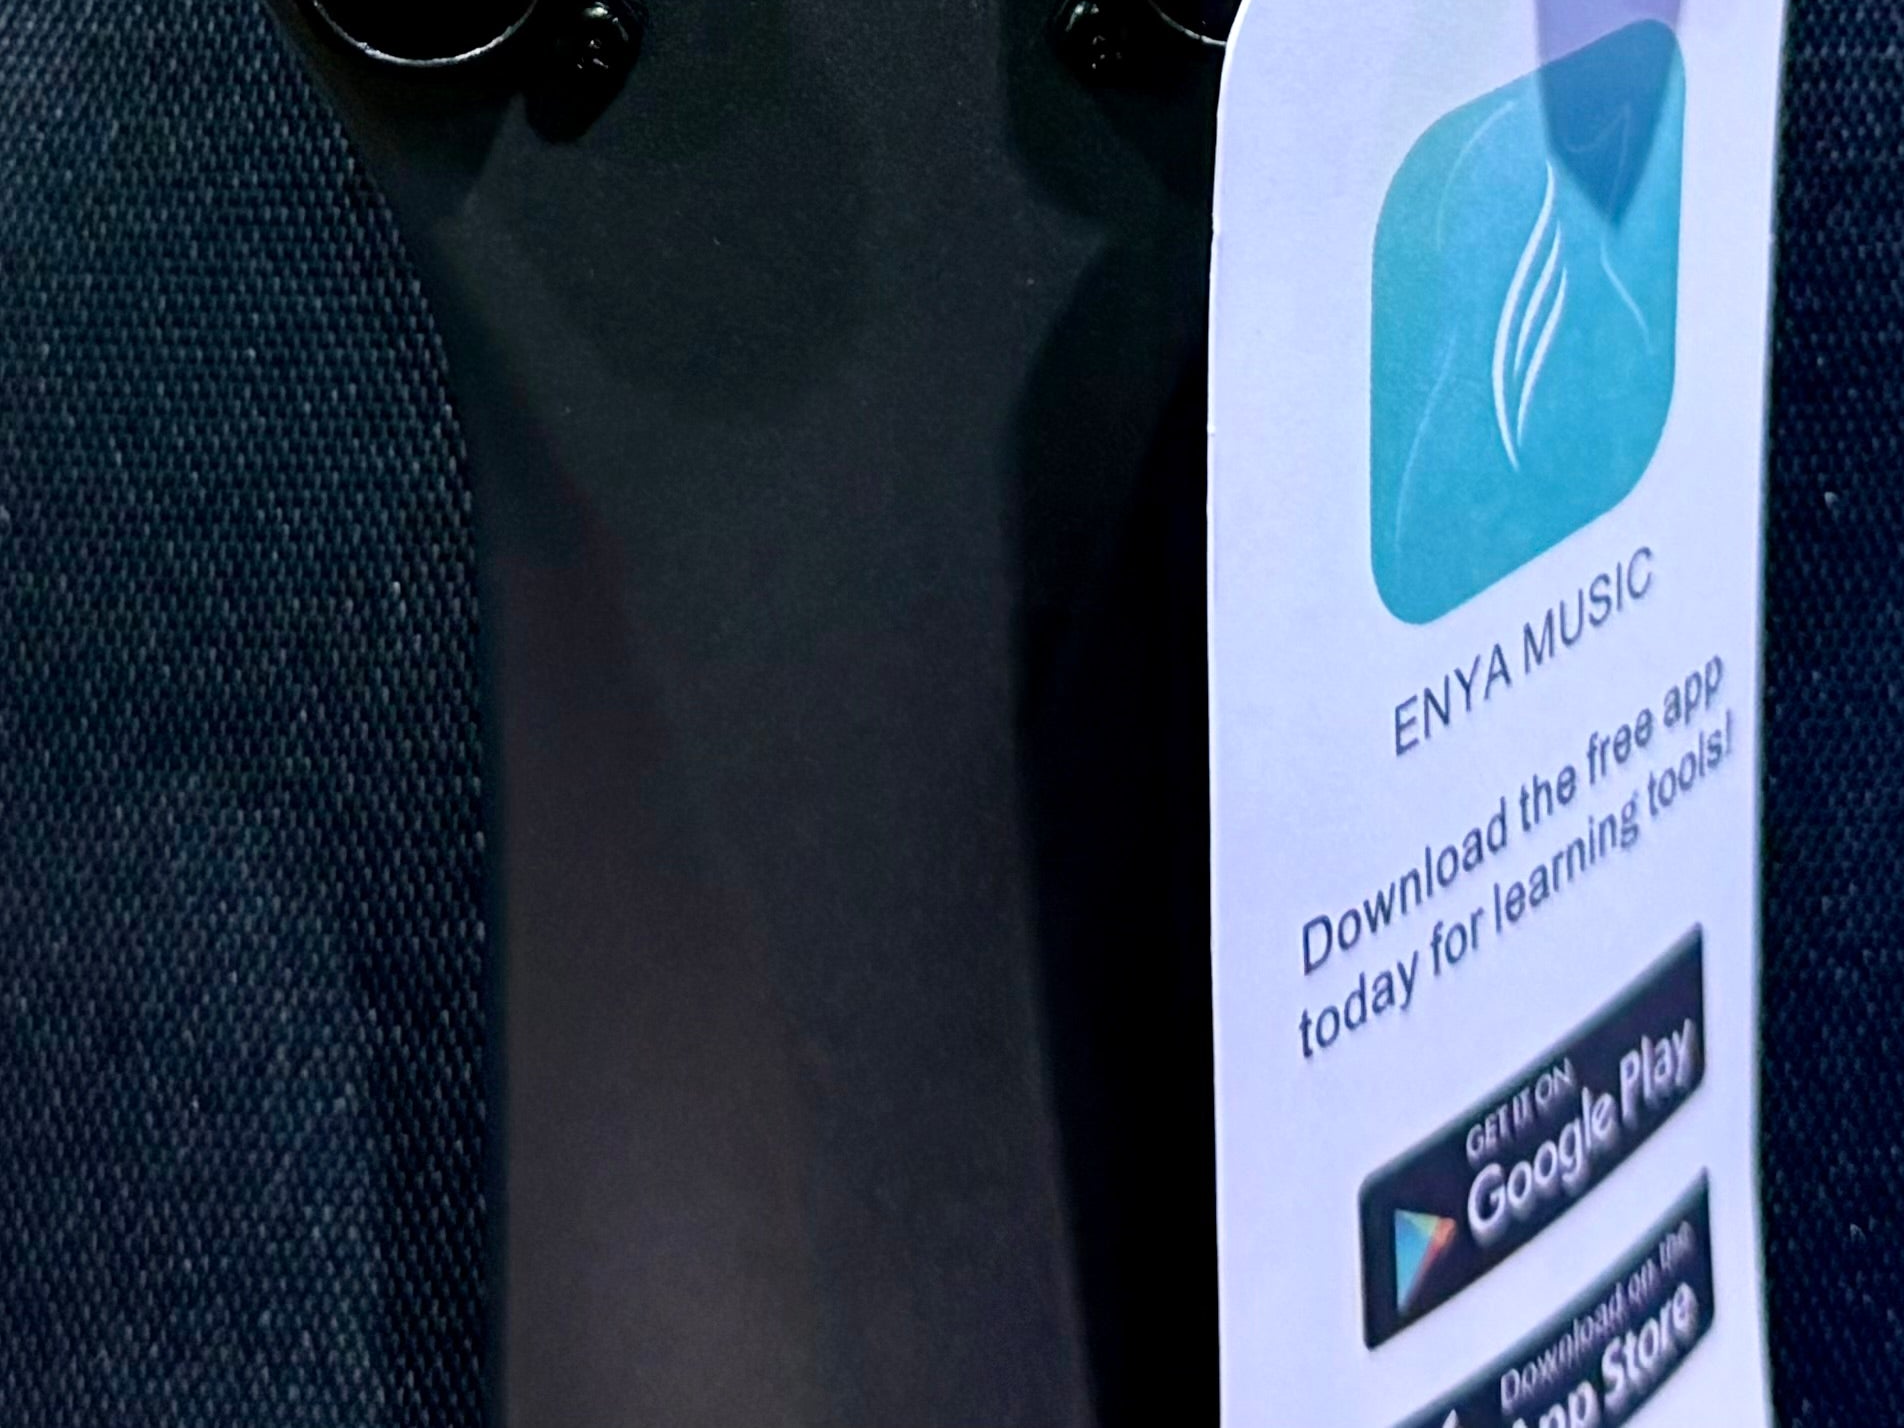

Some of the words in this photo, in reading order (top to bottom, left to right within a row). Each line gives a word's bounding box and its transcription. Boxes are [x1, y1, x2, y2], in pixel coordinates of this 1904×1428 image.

[1394, 643, 1512, 757] ENYA
[1522, 545, 1654, 676] MUSIC
[1298, 950, 1420, 1059] today
[1430, 906, 1485, 976] for
[1494, 792, 1642, 933] learning
[1646, 708, 1735, 818] tools!
[1302, 795, 1507, 976] Download
[1519, 764, 1577, 832] the
[1586, 708, 1653, 785] free
[1662, 655, 1724, 728] app
[1465, 1103, 1510, 1163] GET
[1534, 1056, 1575, 1111] ON
[1466, 1086, 1617, 1236] Google
[1619, 1017, 1696, 1121] Play
[1500, 1281, 1626, 1414] Download
[1601, 1281, 1698, 1409] Store
